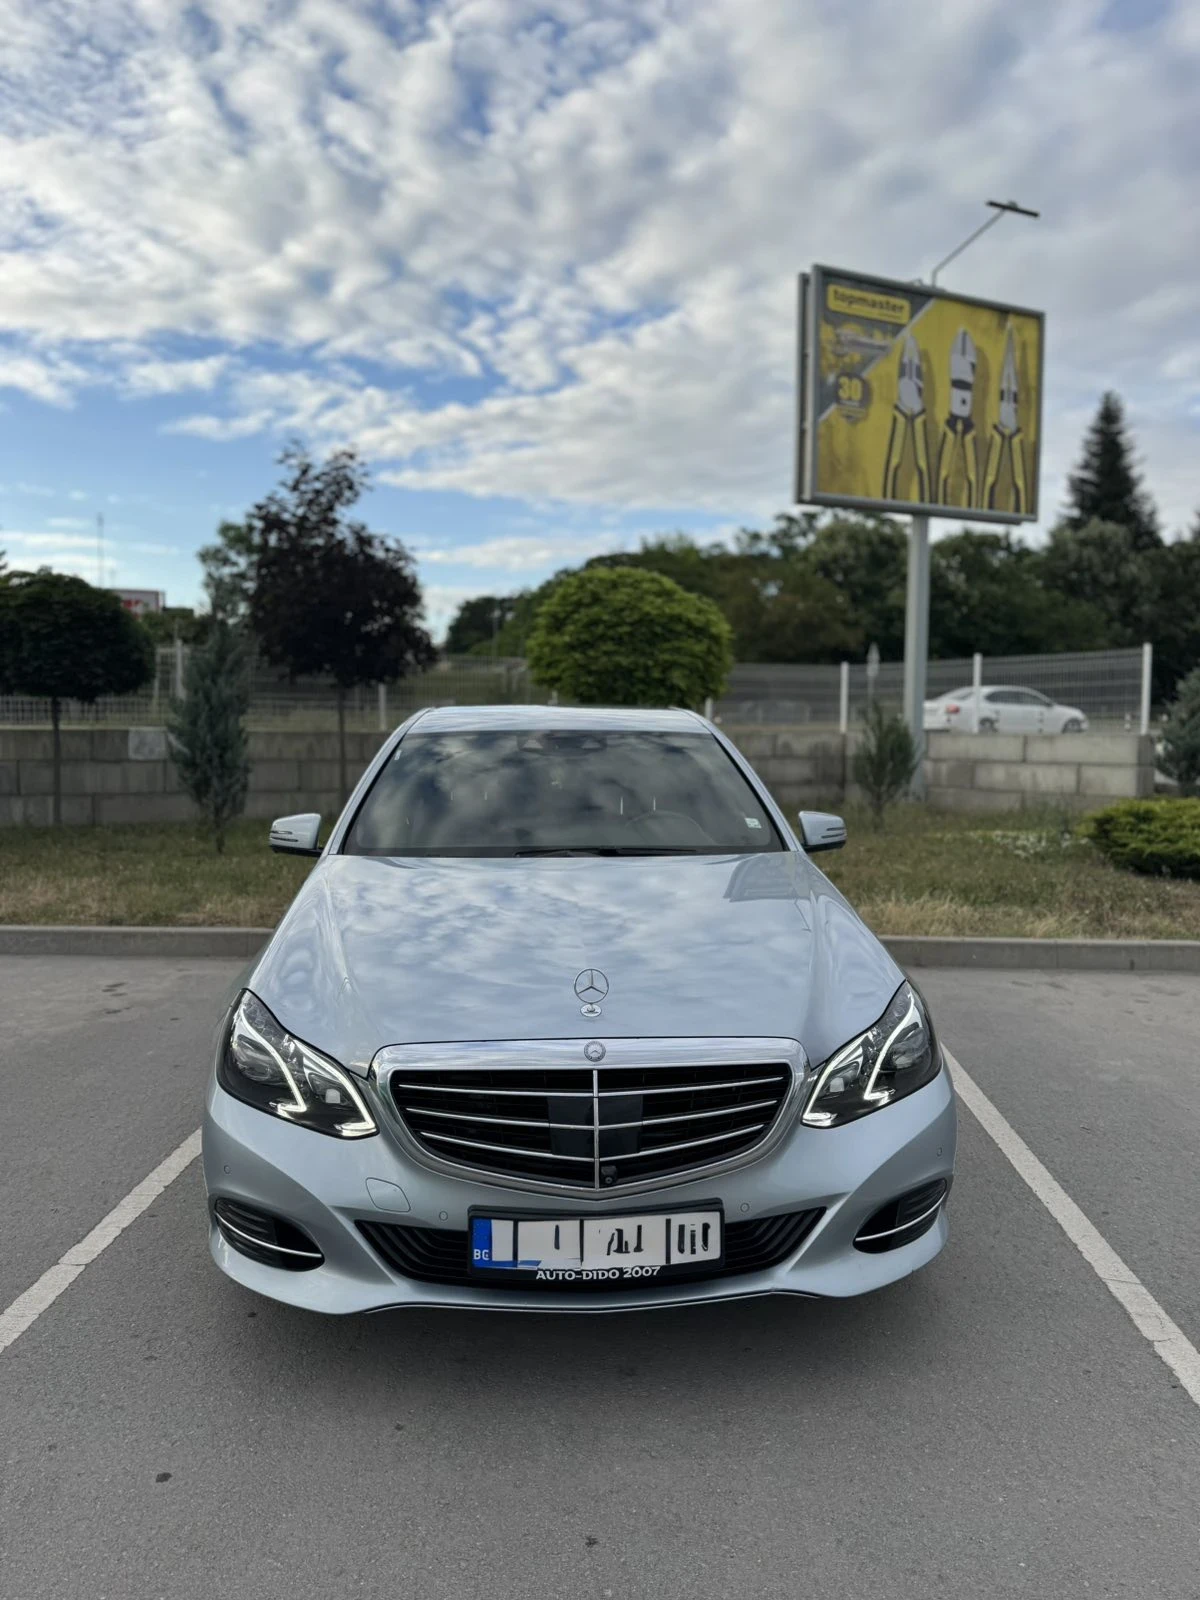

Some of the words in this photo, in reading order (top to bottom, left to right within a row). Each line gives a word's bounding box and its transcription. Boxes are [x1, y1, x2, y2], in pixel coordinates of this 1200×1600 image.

[833, 289, 904, 313] topmaster
[473, 1249, 490, 1261] BG
[535, 1268, 620, 1281] AUTO-DIDO
[623, 1265, 661, 1279] 2007
